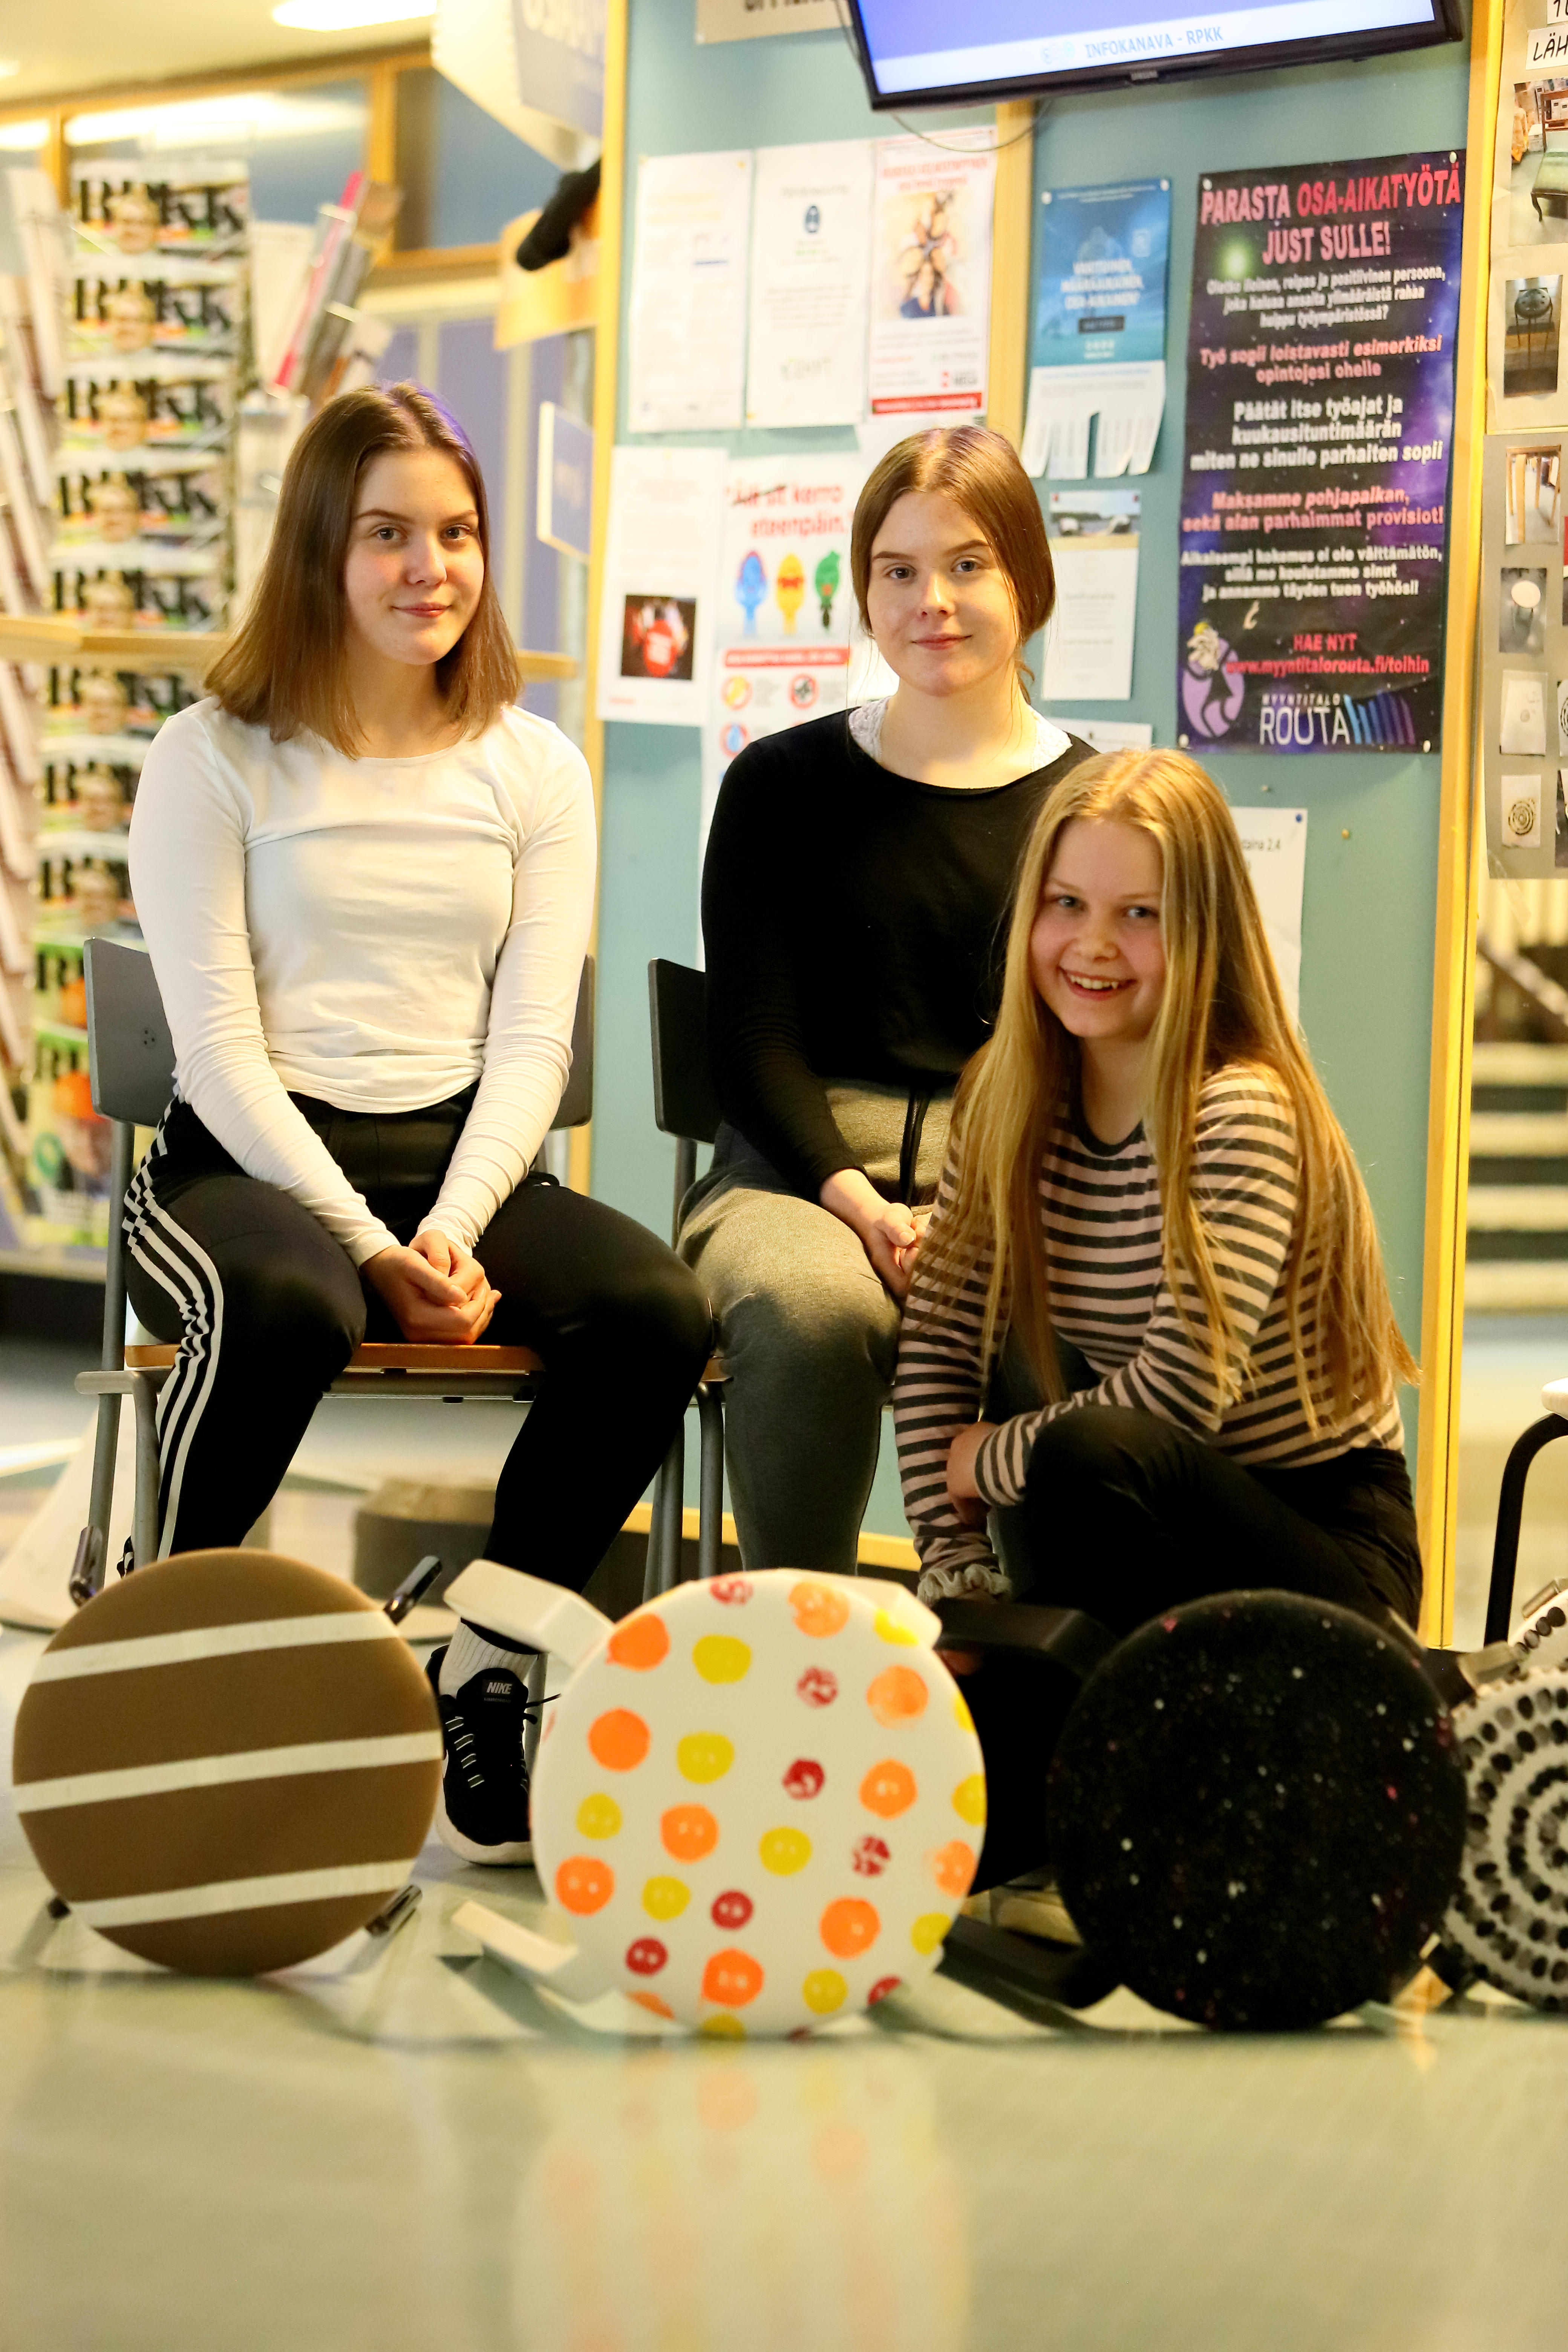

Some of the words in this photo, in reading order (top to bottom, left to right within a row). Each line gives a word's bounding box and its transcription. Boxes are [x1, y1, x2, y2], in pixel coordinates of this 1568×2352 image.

[1085, 34, 1174, 58] INFOKANAVA
[1185, 26, 1224, 45] RPKK
[1200, 184, 1291, 225] PARASTA
[1297, 162, 1461, 217] OSA-AIKATYÖTÄ
[1262, 227, 1314, 265] JUST
[1320, 222, 1390, 261] SULLE!
[1317, 271, 1329, 291] ja
[1393, 266, 1446, 285] persoona,
[1394, 284, 1425, 301] rahaa
[1200, 348, 1227, 369] Työ
[1230, 345, 1267, 366] sopii
[1270, 340, 1349, 361] loistavasti
[1353, 334, 1442, 357] esimerkiksi
[1256, 362, 1331, 386] opintojesi
[1335, 359, 1382, 379] ohelle
[1234, 400, 1287, 422] Päätät
[1291, 397, 1322, 419] itse
[1326, 395, 1383, 421] työajat
[1386, 394, 1403, 420] ja
[1232, 419, 1402, 446] kuukausituntimäärän
[1190, 450, 1236, 471] miten
[1239, 452, 1259, 469] ne
[1263, 447, 1317, 468] sinulle
[1320, 443, 1398, 470] parhaiten
[1402, 440, 1444, 465] sopii
[1212, 491, 1302, 510] Maksamme
[1305, 486, 1410, 510] pohjapalkan,
[1183, 514, 1221, 532] sekä
[1225, 512, 1259, 531] alan
[1263, 508, 1361, 533] parhaimmat
[1366, 506, 1444, 530] provisiot!
[1256, 547, 1315, 564] kokemus
[1317, 546, 1330, 562] ei
[1332, 545, 1355, 562] ole
[1357, 544, 1442, 562] välttämätön,
[1256, 568, 1276, 582] me
[1278, 564, 1360, 581] koulutamme
[1363, 563, 1398, 579] sinut
[1202, 584, 1217, 603] ja
[1283, 582, 1328, 601] täyden
[1330, 582, 1362, 597] tuen
[1293, 634, 1323, 651] HAE
[1326, 633, 1357, 651] NYT
[1259, 706, 1351, 746] ROUTA
[486, 1682, 512, 1695] NIKE
